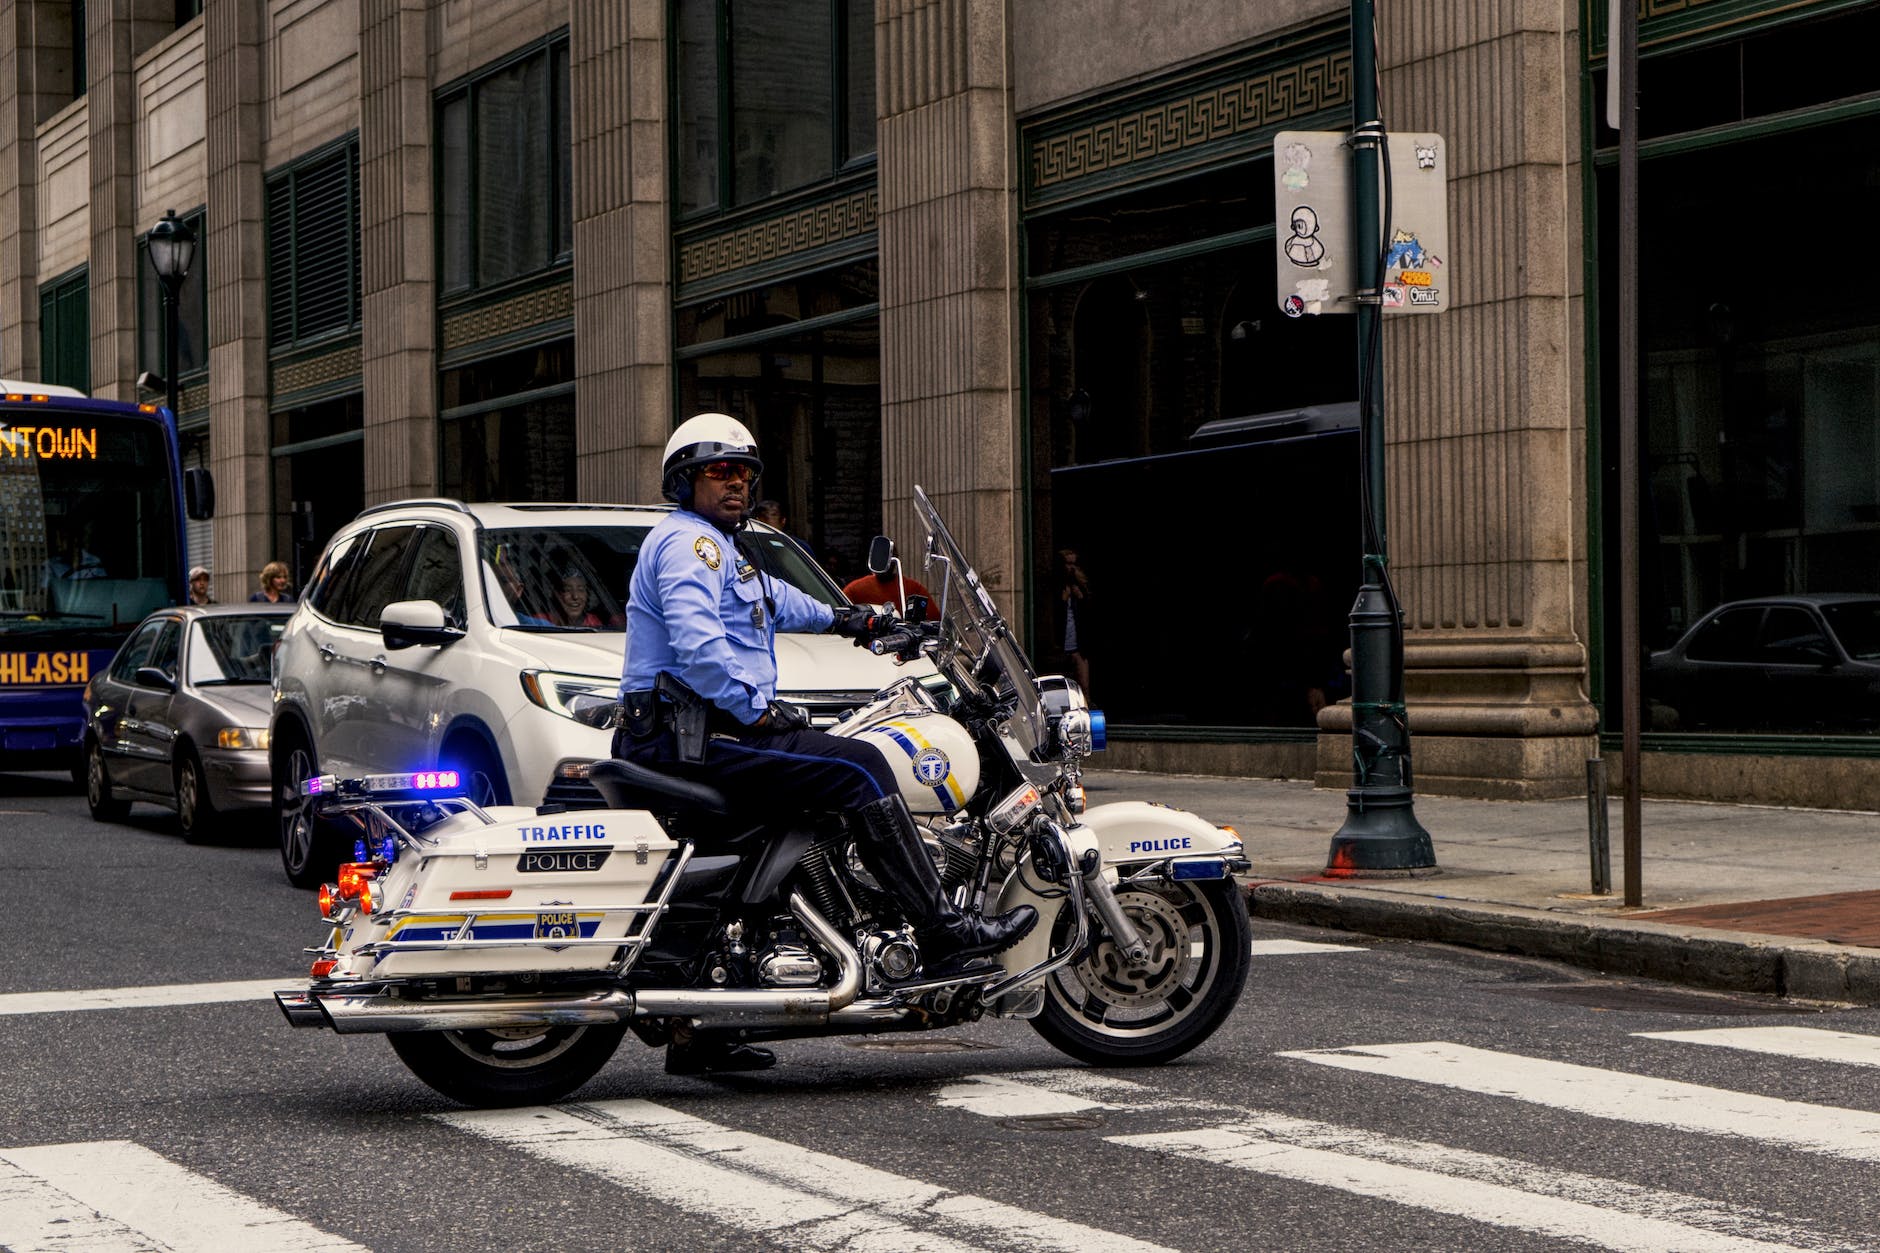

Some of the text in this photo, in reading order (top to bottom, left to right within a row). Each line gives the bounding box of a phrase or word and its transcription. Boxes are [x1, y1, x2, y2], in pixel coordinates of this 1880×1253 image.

[0, 427, 96, 459] NTOWN
[0, 652, 88, 683] HLASH
[518, 825, 606, 841] TRAFFIC
[1130, 837, 1192, 853] POLICE
[526, 854, 597, 870] POLICE
[541, 912, 573, 925] POLICE
[441, 930, 475, 941] T50
